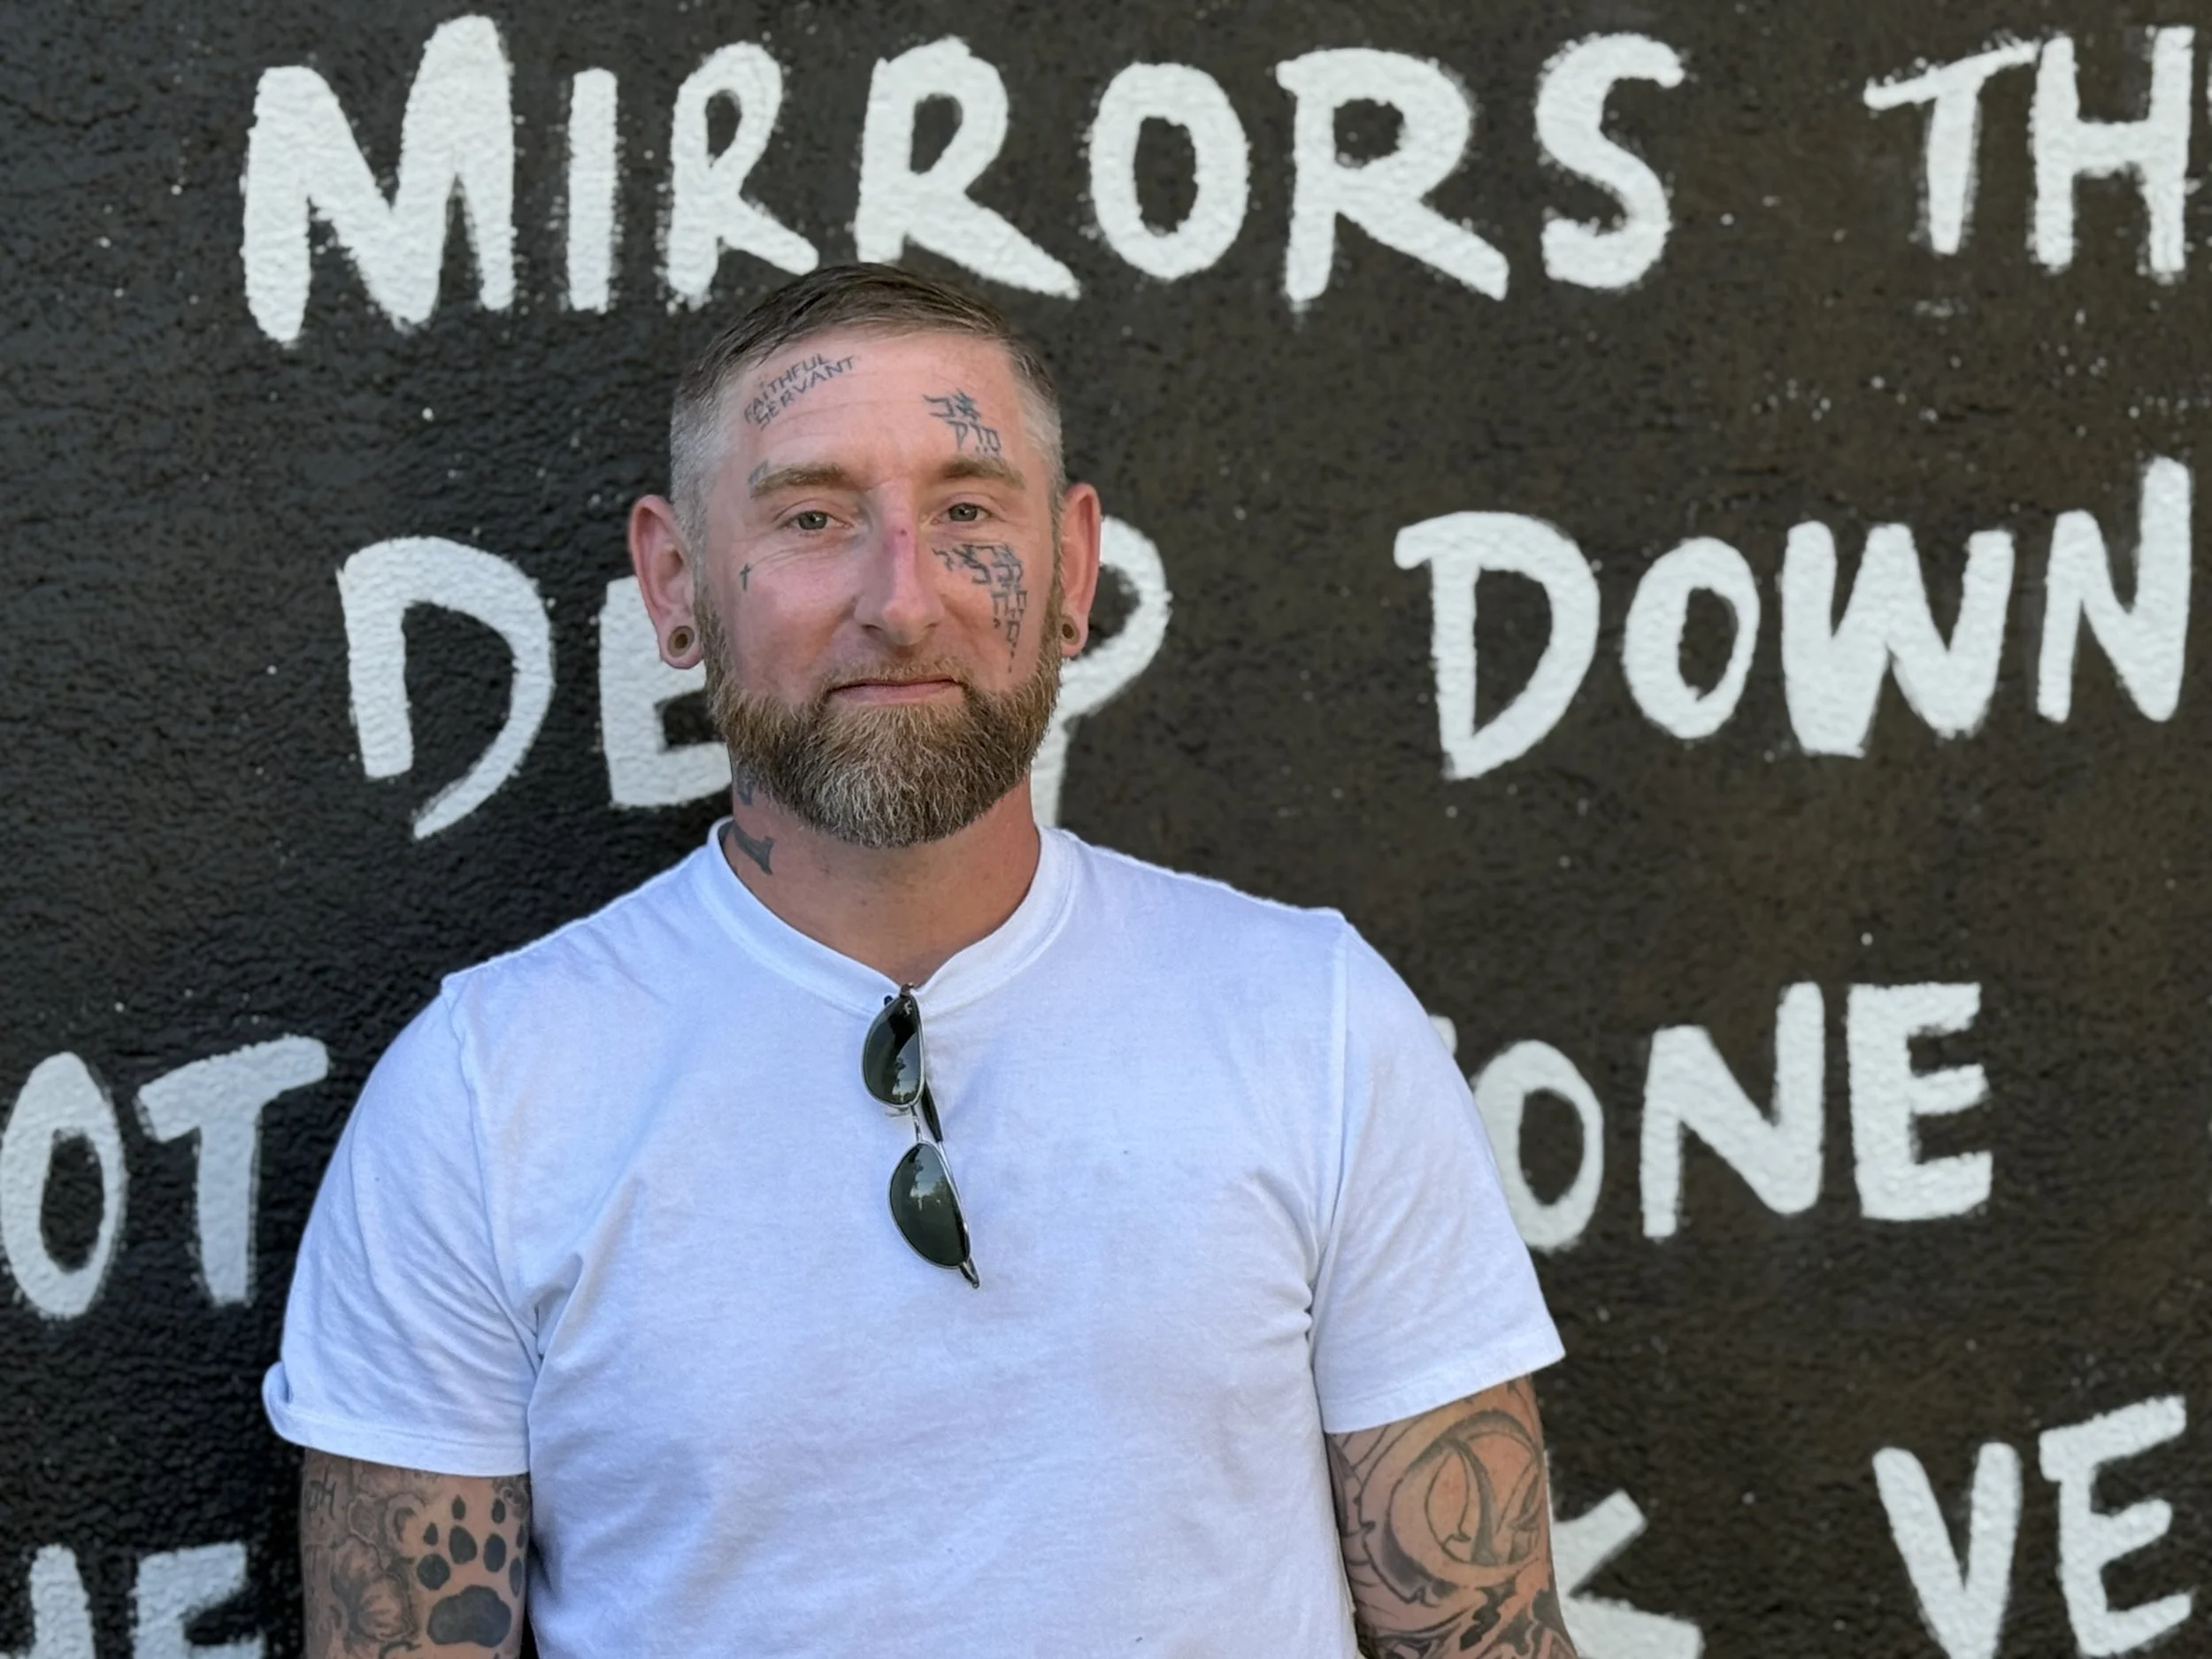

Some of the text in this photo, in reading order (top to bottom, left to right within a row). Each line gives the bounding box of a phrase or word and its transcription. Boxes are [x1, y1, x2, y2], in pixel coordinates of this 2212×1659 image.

[241, 13, 2212, 343] MIRRORS TH
[744, 353, 829, 425] FAITHFUL
[755, 355, 854, 432] SERVANT
[335, 516, 1171, 841] DEP
[1394, 456, 2193, 780] DOWN
[1427, 981, 1994, 1253] ONE
